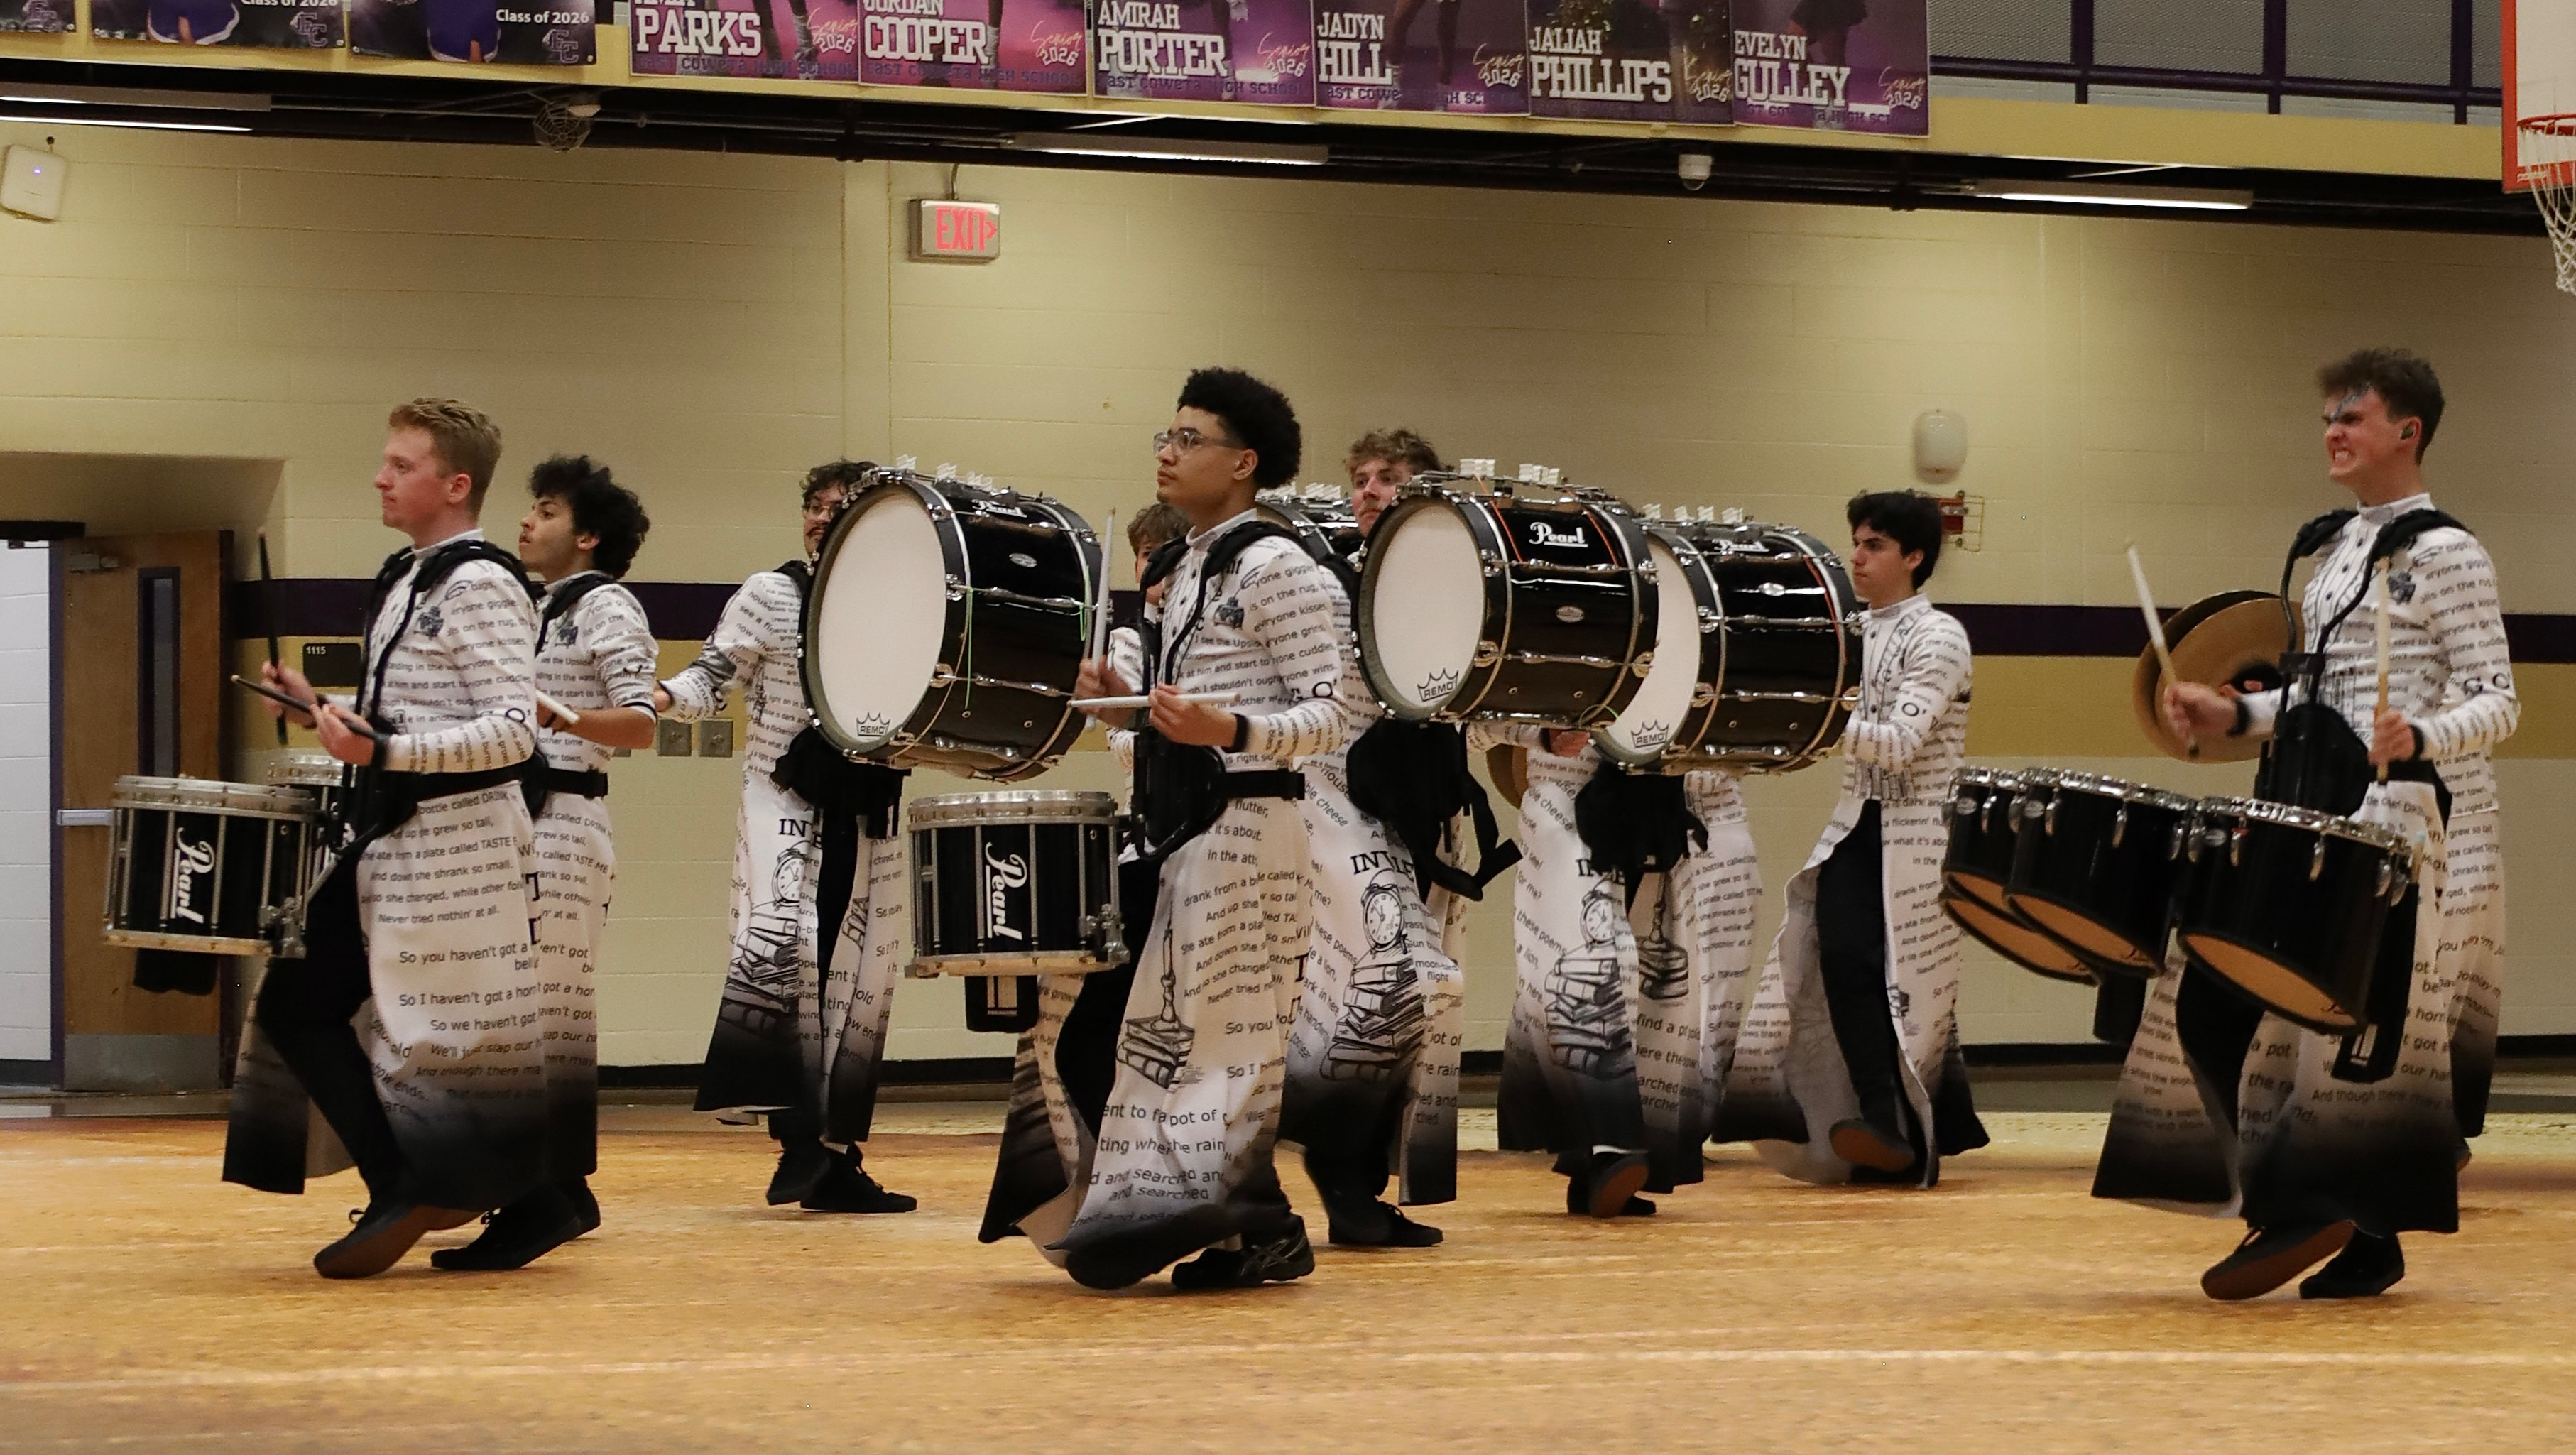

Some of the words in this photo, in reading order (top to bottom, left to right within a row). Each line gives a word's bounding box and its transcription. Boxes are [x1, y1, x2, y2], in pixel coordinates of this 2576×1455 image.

[496, 9, 531, 23] Class
[534, 11, 550, 23] of
[552, 12, 589, 24] 2026
[1098, 1, 1181, 30] AMIRAH
[635, 8, 762, 56] PARKS
[1317, 11, 1385, 40] JADYN
[817, 34, 856, 53] 2026
[864, 15, 989, 64] COOPER
[1529, 26, 1602, 55] JALIAH
[1734, 30, 1808, 60] EVELYN
[1042, 47, 1079, 67] 2026
[1098, 28, 1228, 77] PORTER
[1267, 58, 1306, 77] 2026
[1319, 40, 1393, 85] HILL
[1482, 69, 1522, 87] 2026
[1530, 55, 1671, 102] PHILLIPS
[1734, 58, 1850, 107] GULLEY
[1695, 84, 1730, 102] 2026
[1886, 92, 1922, 109] 2026
[936, 207, 988, 251] EXIT
[1529, 521, 1588, 547] Pearl
[1260, 596, 1275, 607] on
[1277, 589, 1297, 600] the
[306, 646, 326, 655] 1115
[1214, 663, 1232, 673] and
[1235, 660, 1257, 670] start
[1422, 681, 1454, 698] REMO
[860, 725, 886, 734] REMO
[1636, 734, 1664, 744] REMO
[1316, 797, 1348, 827] cheese
[1540, 792, 1574, 832] cheese
[432, 824, 459, 837] grew
[462, 820, 474, 830] so
[1215, 824, 1229, 835] it's
[481, 837, 512, 849] TASTE
[1207, 850, 1218, 861] in
[1221, 851, 1238, 863] the
[171, 826, 216, 924] Pearl
[435, 866, 469, 879] shrank
[471, 864, 484, 873] so
[594, 861, 609, 874] ME
[985, 841, 1027, 940] Pearl
[1184, 893, 1211, 908] drank
[1214, 881, 1238, 896] from
[1240, 879, 1247, 888] a
[378, 913, 409, 923] Never
[1206, 909, 1226, 923] And
[1228, 903, 1238, 915] up
[1242, 899, 1259, 909] she
[1198, 935, 1214, 947] ate
[1240, 922, 1246, 931] a
[399, 951, 417, 964] So
[421, 953, 446, 965] you
[449, 946, 497, 962] haven't
[499, 944, 517, 958] got
[568, 947, 589, 959] got
[1240, 942, 1257, 953] she
[1213, 971, 1228, 983] she
[542, 982, 561, 993] got
[564, 984, 571, 993] a
[400, 994, 415, 1006] So
[420, 993, 425, 1005] I
[430, 991, 481, 1004] haven't
[484, 990, 503, 1005] got
[506, 990, 513, 998] a
[430, 1020, 447, 1031] So
[451, 1020, 469, 1030] we
[474, 1014, 518, 1030] haven't
[573, 1010, 592, 1020] got
[1636, 1013, 1663, 1030] find
[1666, 1022, 1674, 1034] a
[1225, 1022, 1244, 1035] So
[1248, 1018, 1273, 1033] you
[561, 1032, 582, 1042] our
[2265, 1042, 2293, 1058] pot
[2248, 1073, 2274, 1089] the
[1130, 1104, 1147, 1119] to
[1169, 1111, 1196, 1132] pot
[1201, 1109, 1218, 1123] of
[1196, 1139, 1226, 1152] rain
[1136, 1186, 1209, 1200] searched
